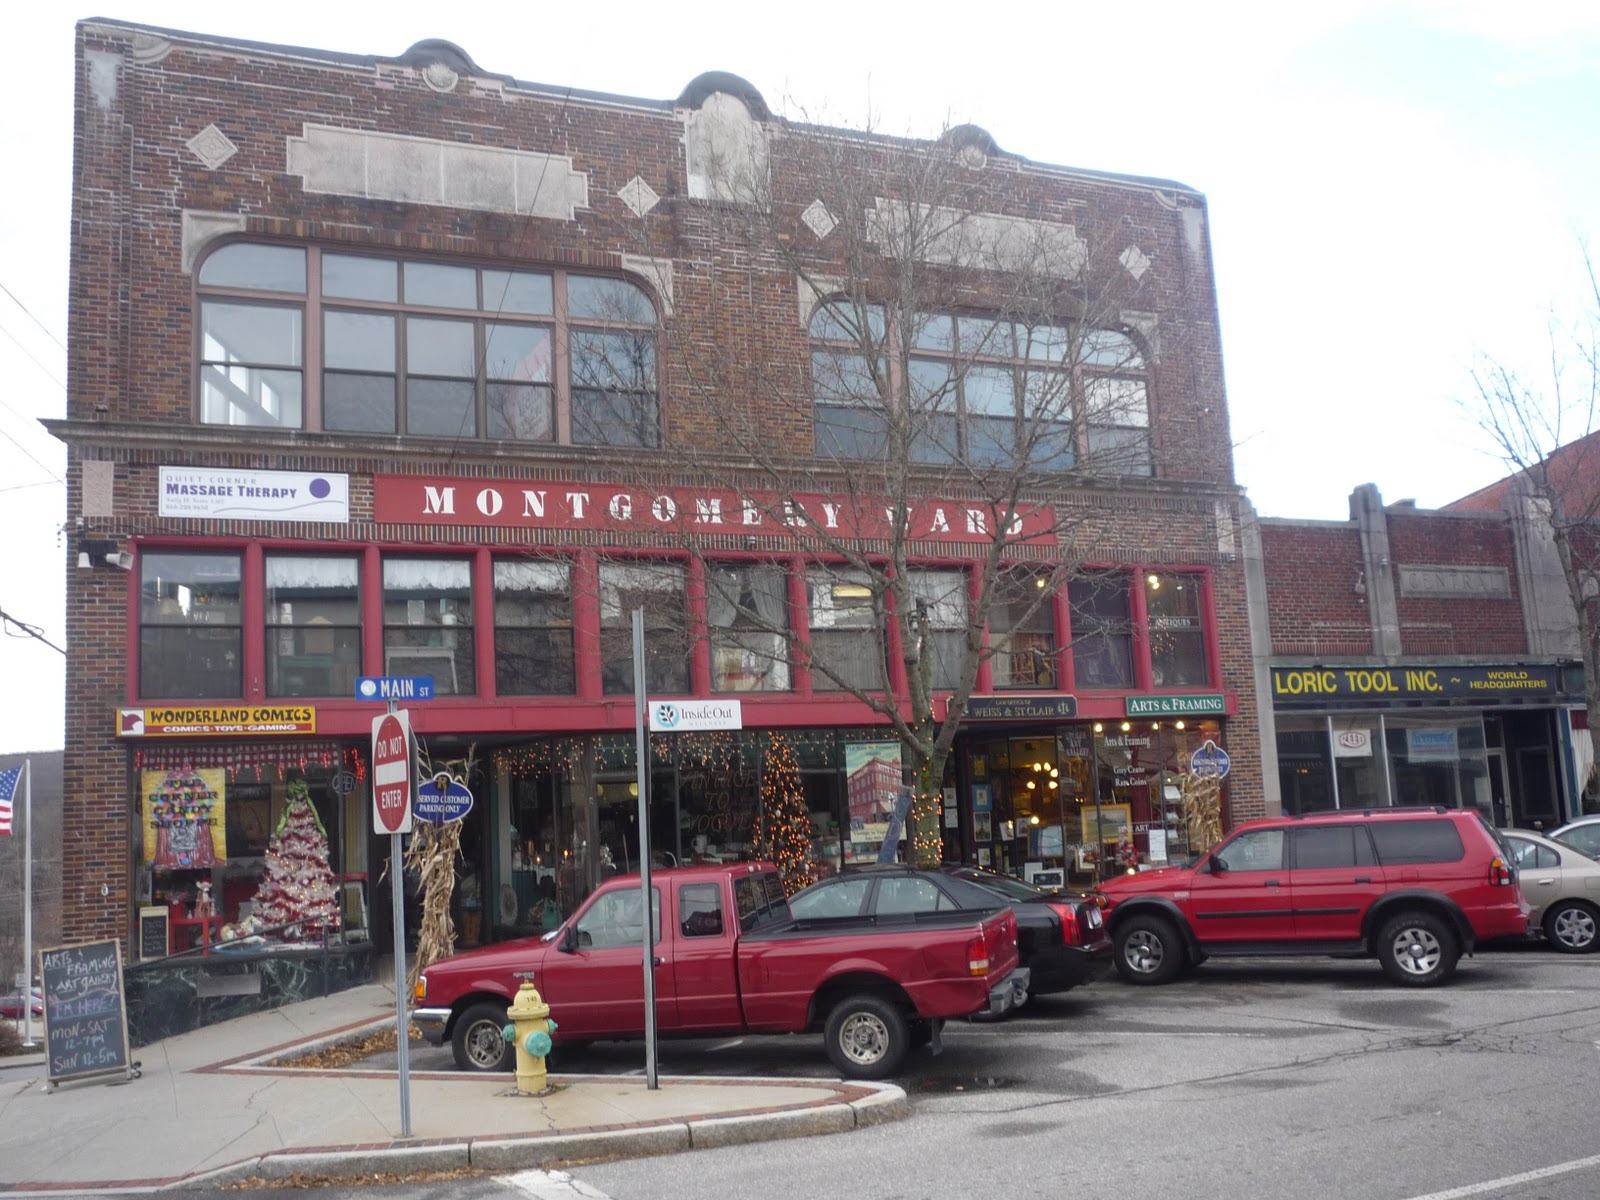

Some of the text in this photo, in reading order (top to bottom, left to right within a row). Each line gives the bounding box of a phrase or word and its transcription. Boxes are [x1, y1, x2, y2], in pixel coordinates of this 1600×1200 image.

[166, 475, 257, 485] QUIET CORNER
[166, 483, 297, 499] MASSAGE THERAPY
[422, 486, 841, 528] MONTGOMERY
[1409, 572, 1499, 592] CENTRAL
[1275, 671, 1337, 694] LORIC
[1345, 670, 1399, 692] TOOL
[1405, 670, 1444, 691] INC.
[1487, 671, 1528, 680] WORLD
[380, 679, 429, 698] MAIN ST
[1470, 679, 1547, 689] HEADQUARTERS
[974, 707, 1002, 717] WEISS
[1004, 707, 1012, 717] &
[1131, 698, 1222, 712] ARTS & FRAMING
[151, 708, 312, 725] WONDERLAND COMICS
[163, 724, 297, 733] COMICS TOYS GAMING
[1104, 736, 1118, 747] Arts
[1124, 735, 1150, 749] Framing
[1339, 731, 1365, 748] REED
[377, 736, 402, 758] DO NOT
[331, 774, 357, 791] OPEN
[149, 791, 219, 802] CORNER
[381, 789, 403, 809] ENTER
[418, 795, 470, 805] SERVED CUSTOMER
[154, 804, 212, 814] CANDY
[419, 804, 461, 814] PARKING ONLY
[1135, 824, 1150, 833] ART
